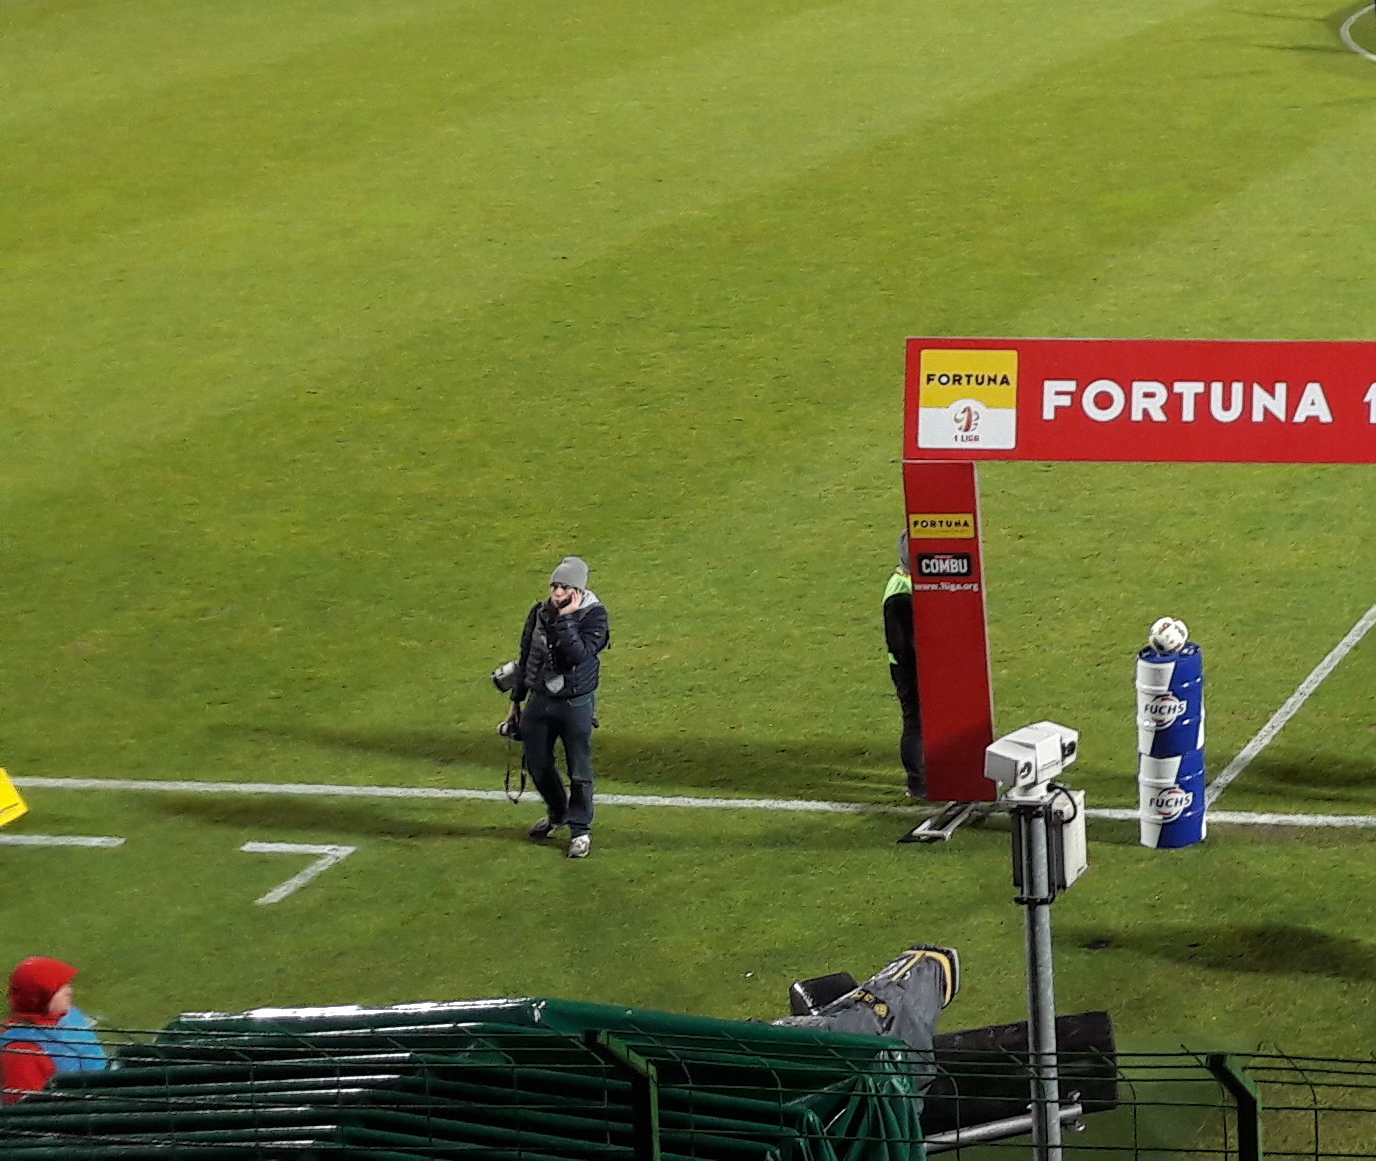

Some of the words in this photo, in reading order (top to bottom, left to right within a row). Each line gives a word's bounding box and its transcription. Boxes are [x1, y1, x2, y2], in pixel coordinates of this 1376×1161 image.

[926, 373, 1010, 386] FORTUNA
[1040, 379, 1334, 424] FORTUNA
[913, 519, 970, 529] FORTUNA
[921, 558, 968, 574] COMBU
[1144, 701, 1185, 716] FUCHS
[1149, 793, 1192, 808] FUCHS
